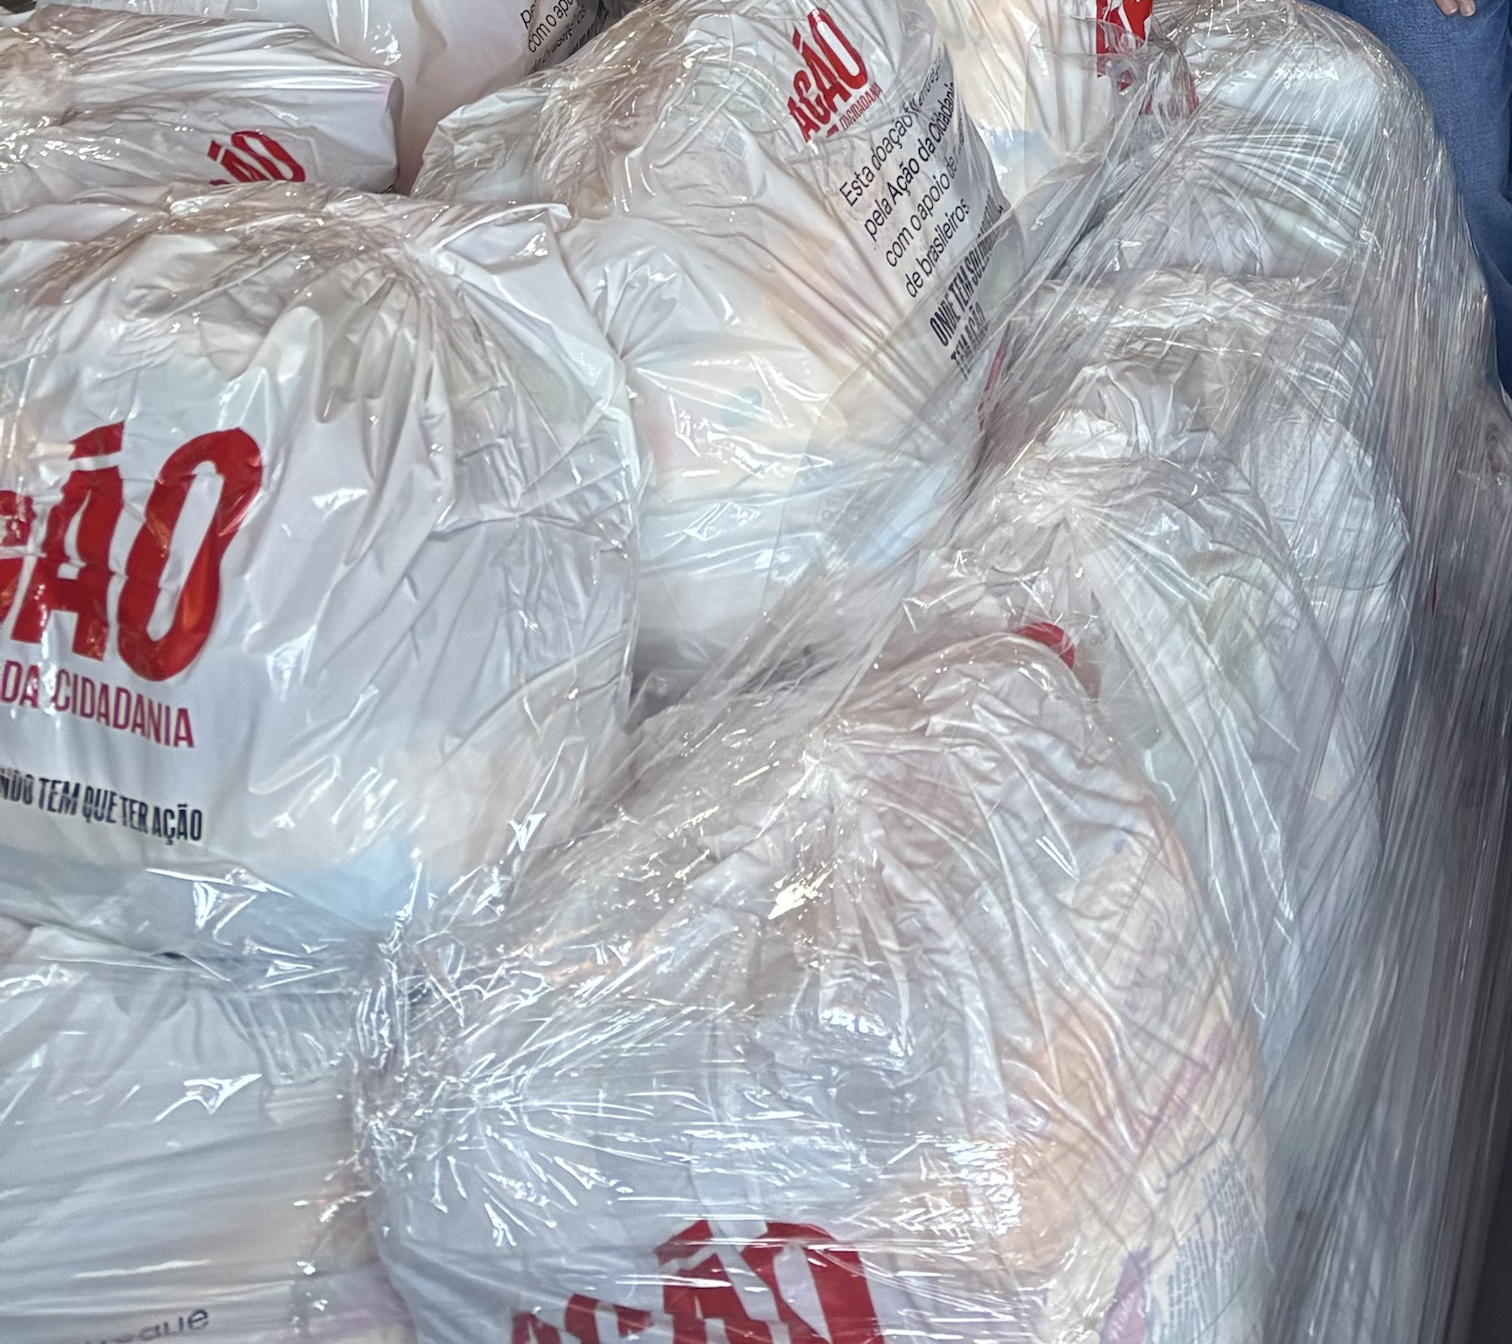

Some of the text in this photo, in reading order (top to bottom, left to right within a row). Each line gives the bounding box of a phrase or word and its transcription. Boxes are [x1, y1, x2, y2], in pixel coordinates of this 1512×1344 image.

[528, 22, 551, 53] com
[546, 14, 557, 27] o
[787, 6, 868, 143] AÇÃO
[839, 165, 876, 207] Esta
[871, 113, 913, 170] doação
[864, 199, 893, 242] pela
[887, 155, 920, 205] Ação
[917, 138, 937, 163] da
[886, 226, 915, 268] com
[910, 213, 922, 231] o
[920, 172, 951, 223] apoio
[905, 273, 925, 299] de
[916, 198, 970, 277] brasileiros
[929, 292, 962, 348] ONDE
[1, 660, 195, 749] DA CIDADANIA
[38, 777, 81, 816] TEM
[82, 785, 118, 824] QUE
[119, 795, 149, 834] TER
[151, 803, 204, 846] AÇÃO
